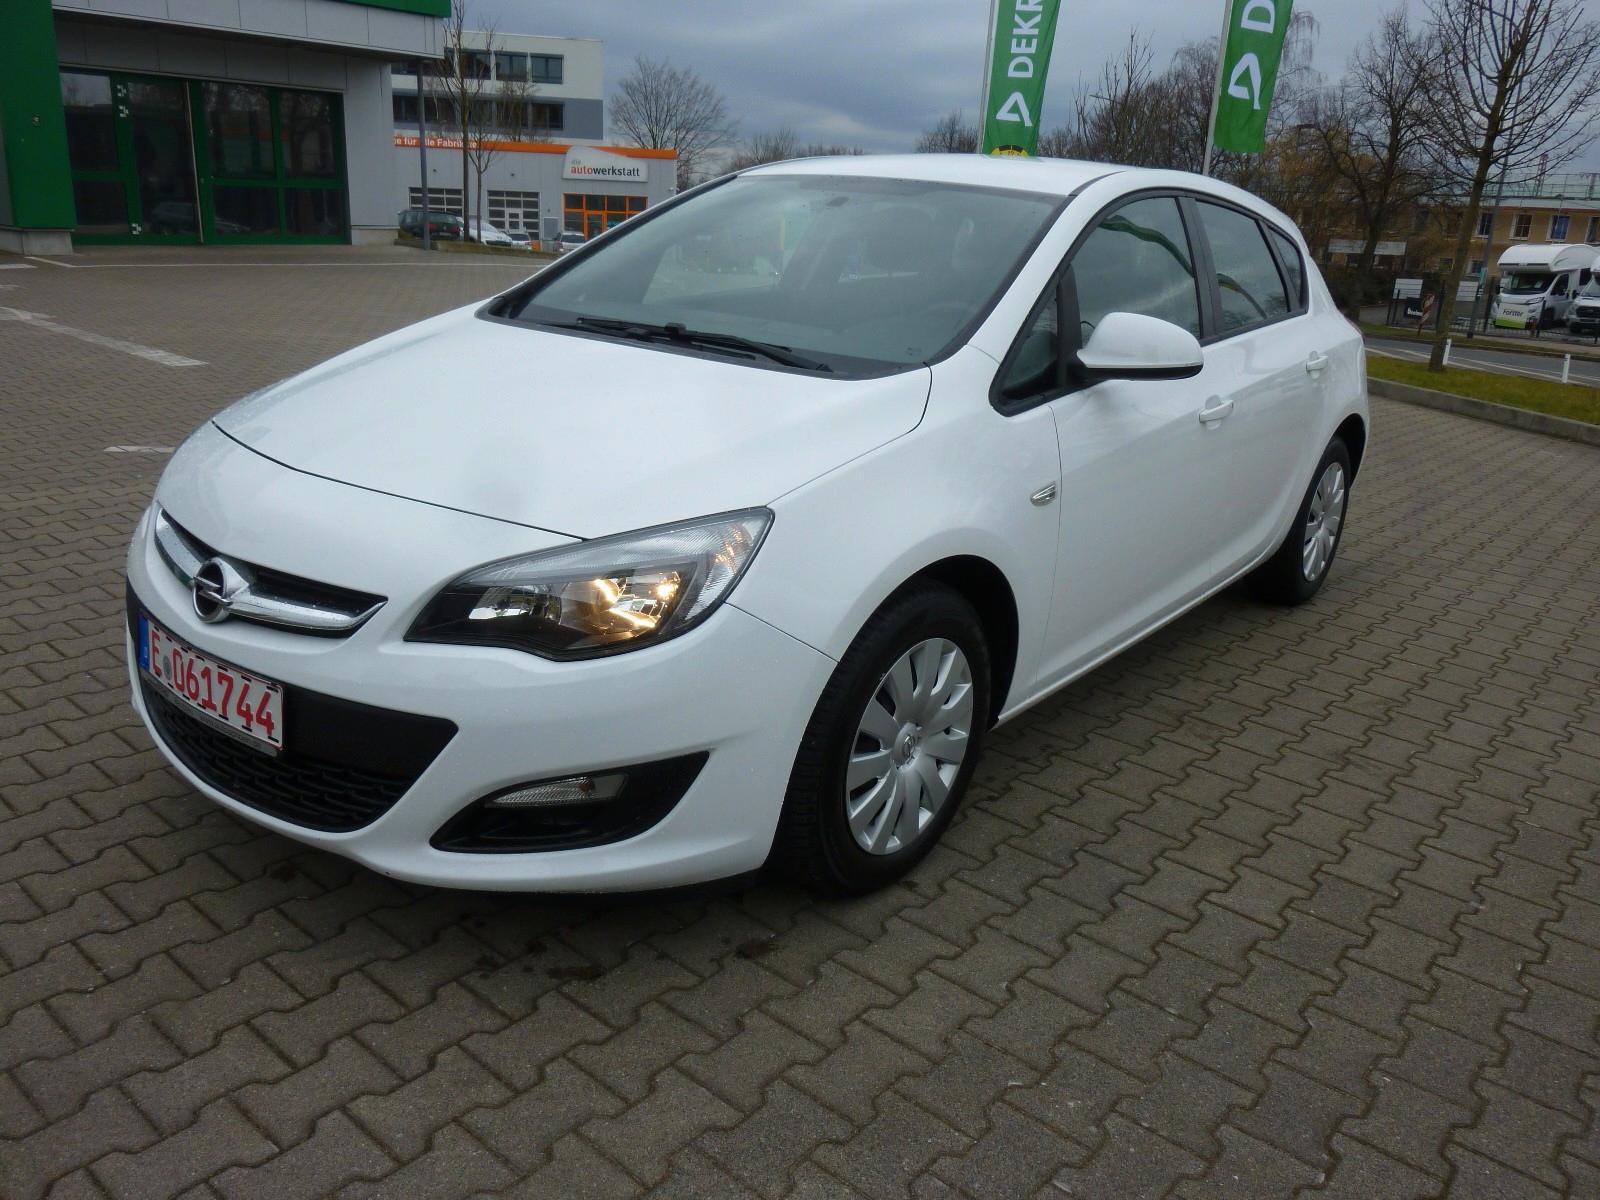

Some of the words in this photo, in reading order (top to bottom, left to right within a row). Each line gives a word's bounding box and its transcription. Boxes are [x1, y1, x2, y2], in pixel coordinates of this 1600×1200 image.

[404, 136, 416, 146] für
[571, 166, 640, 177] autowerkstatt
[152, 629, 162, 676] E
[173, 648, 275, 737] 061744
